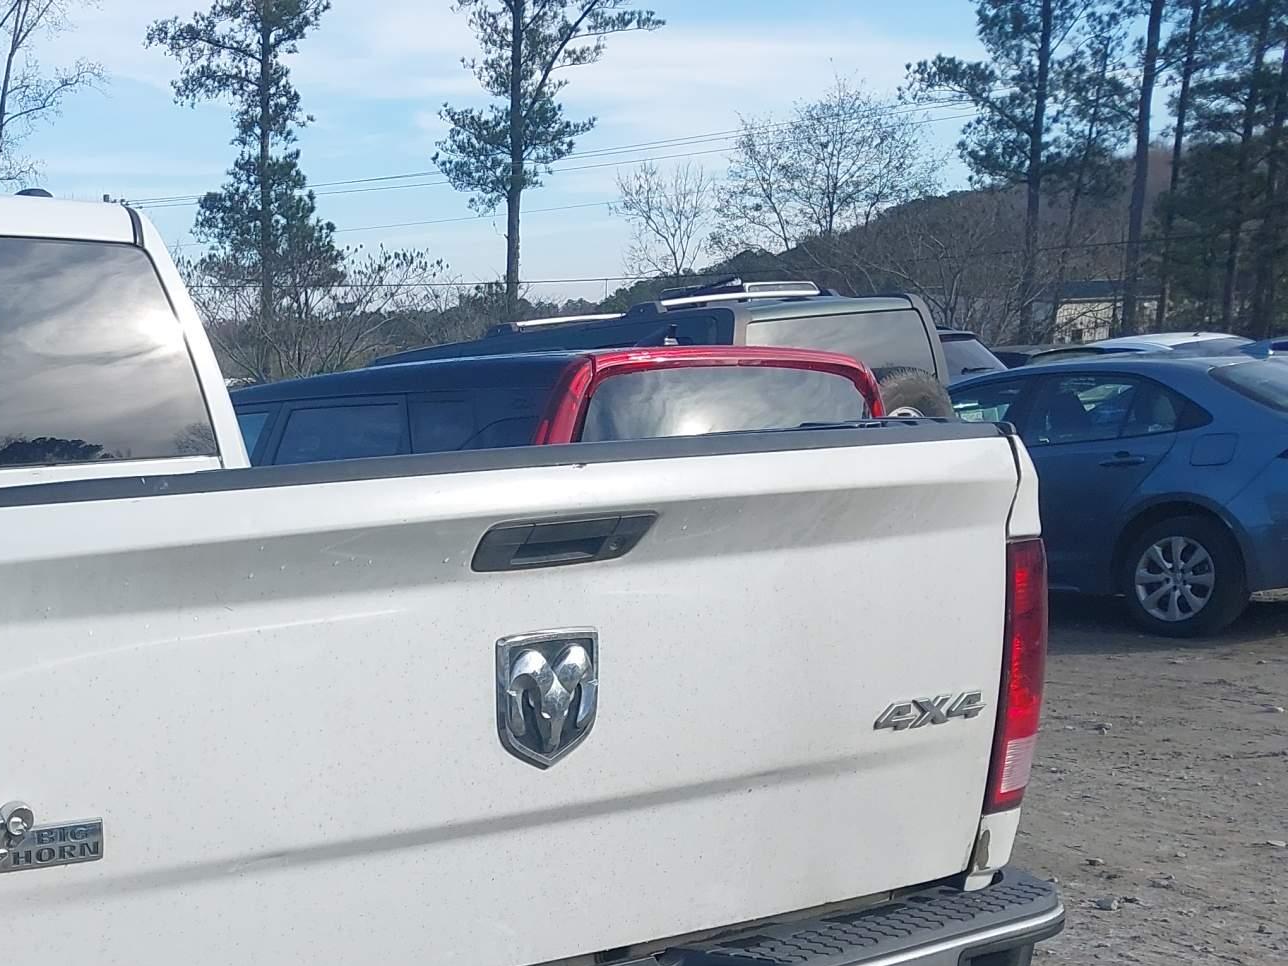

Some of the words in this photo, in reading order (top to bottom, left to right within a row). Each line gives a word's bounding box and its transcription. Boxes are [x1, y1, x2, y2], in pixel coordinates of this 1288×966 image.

[873, 690, 986, 730] 4X4
[36, 825, 89, 845] BIG
[12, 841, 99, 865] HORN
